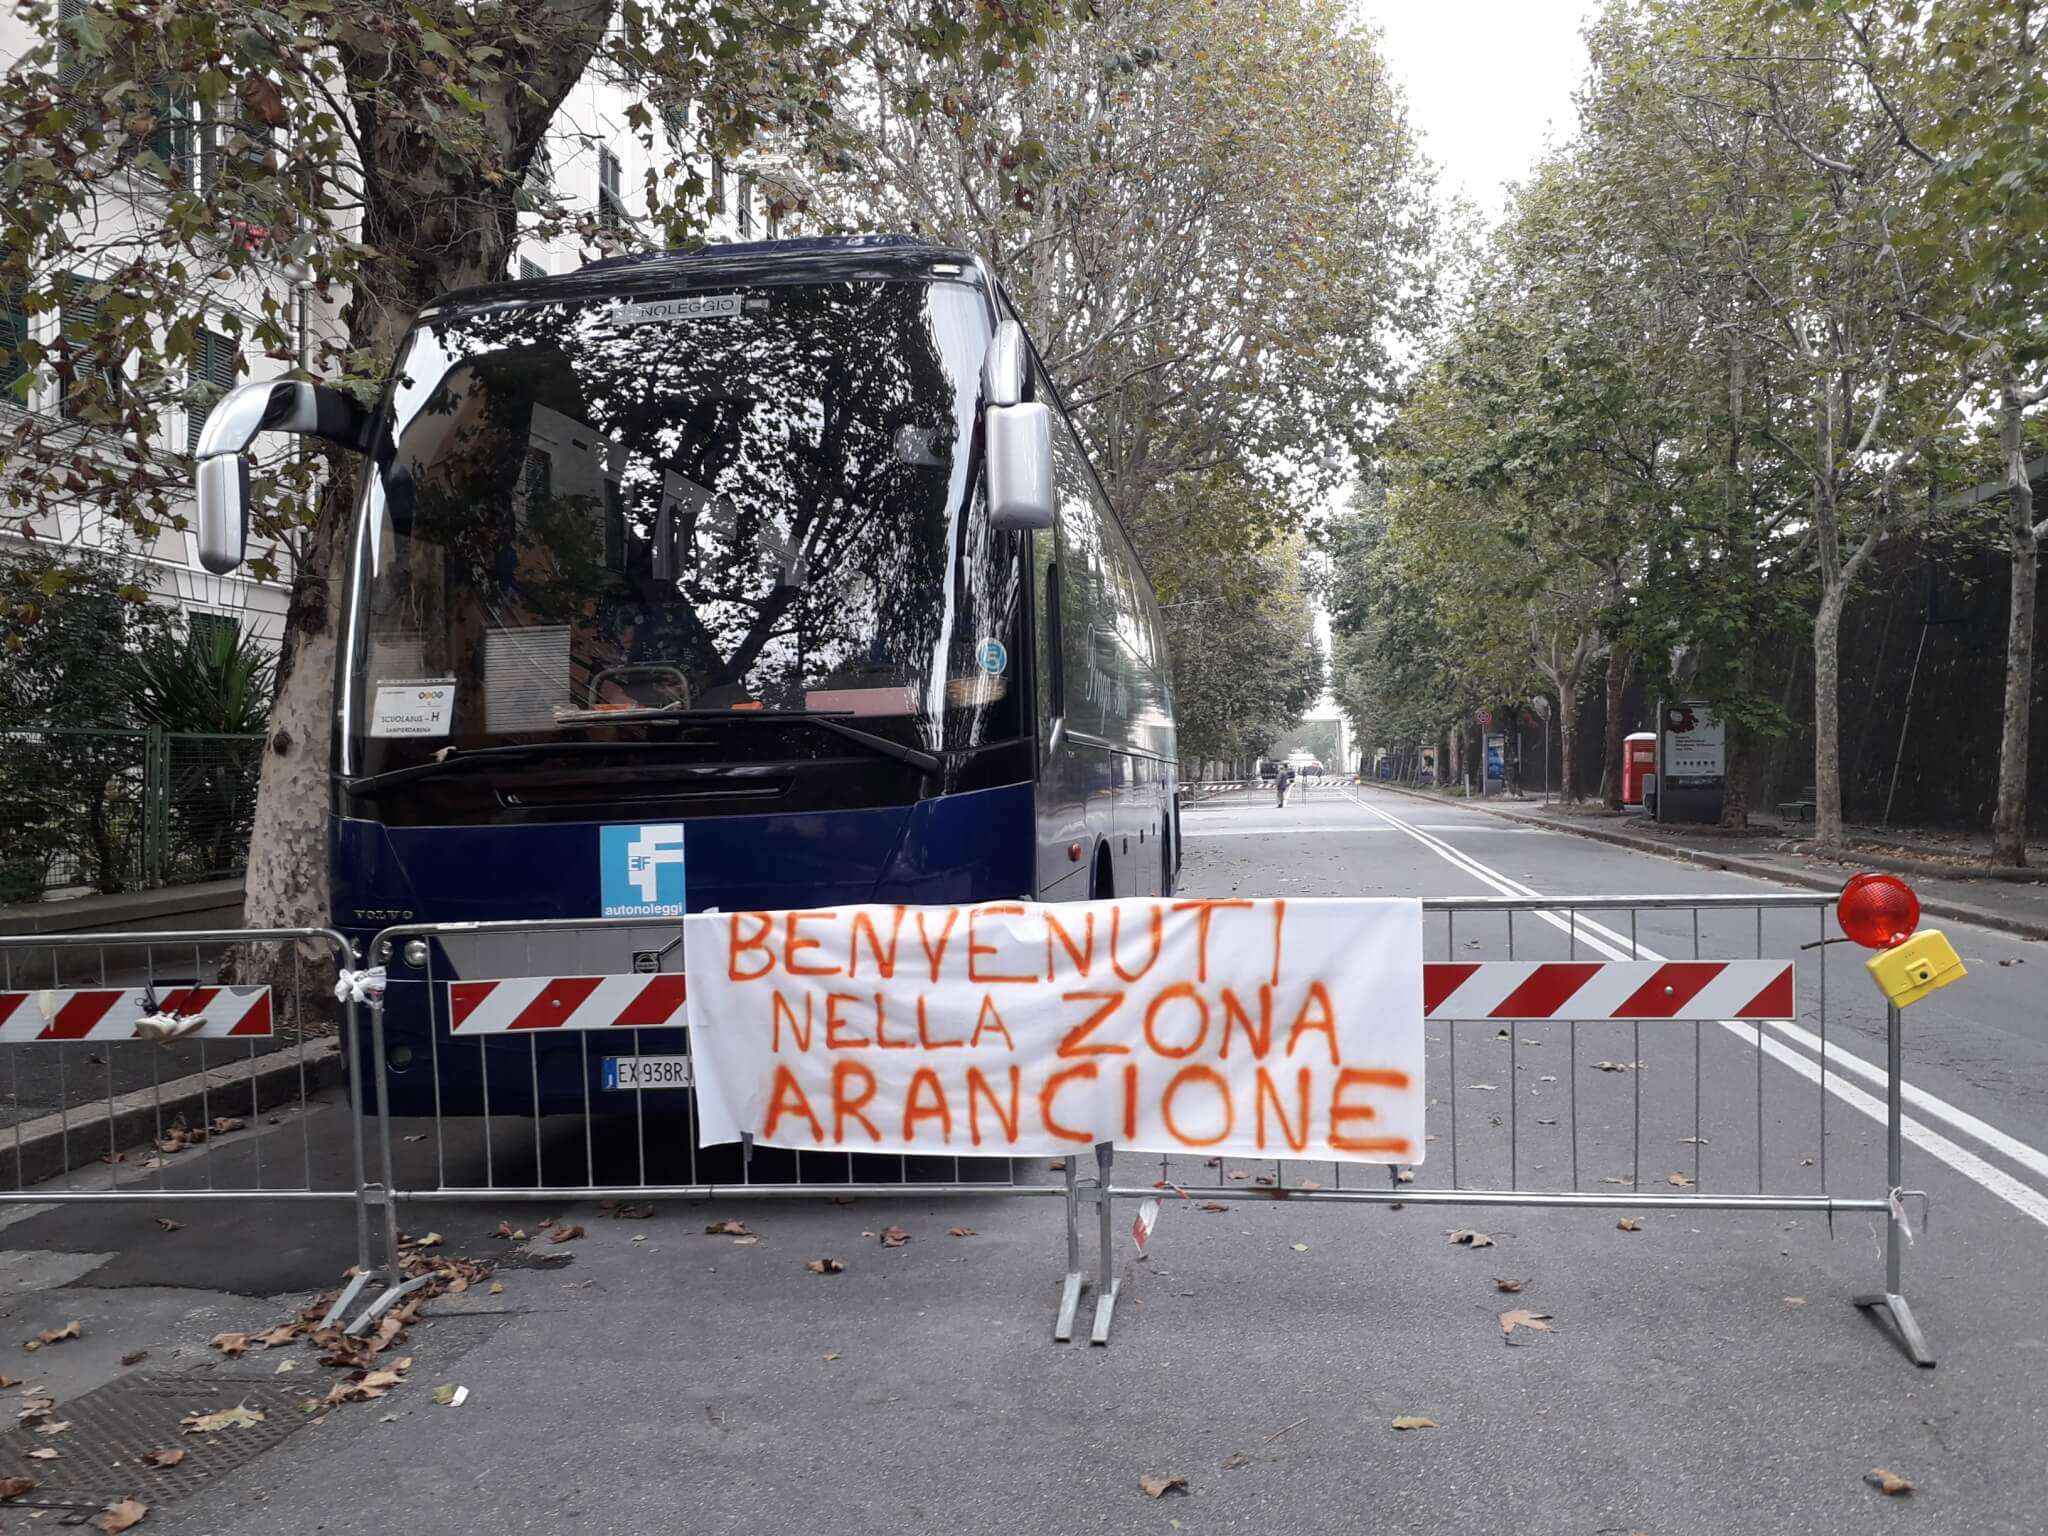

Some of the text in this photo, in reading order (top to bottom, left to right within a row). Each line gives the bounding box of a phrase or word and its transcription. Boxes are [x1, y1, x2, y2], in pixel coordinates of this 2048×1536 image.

[640, 299, 735, 318] NOLEGGIO
[431, 711, 440, 723] H
[605, 902, 683, 916] autonoleggi
[728, 899, 1285, 984] BENVENUTI
[772, 981, 1341, 1067] NELLA ZONA
[763, 1060, 1411, 1152] ARANCIONE
